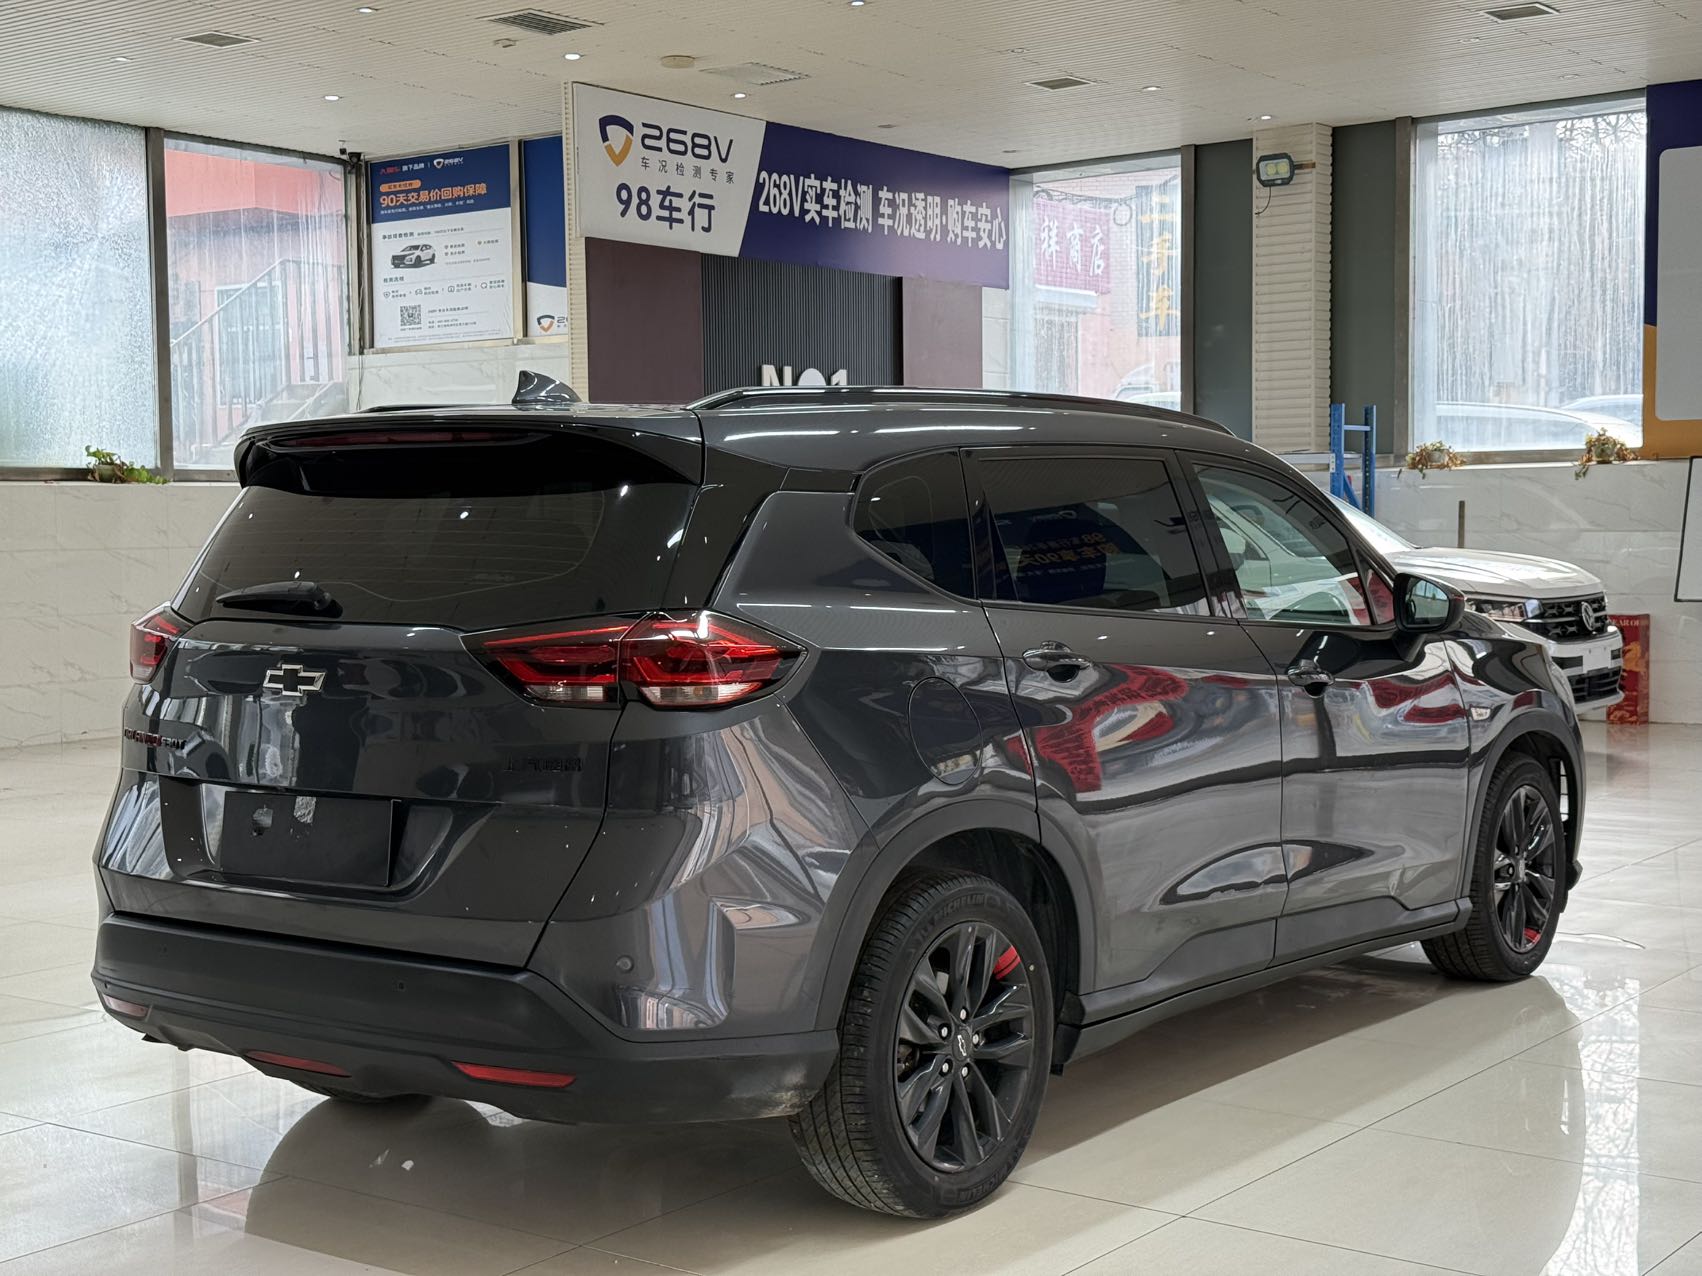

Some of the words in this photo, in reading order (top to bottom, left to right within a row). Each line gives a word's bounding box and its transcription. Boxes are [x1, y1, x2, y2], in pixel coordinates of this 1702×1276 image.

[640, 122, 734, 164] 268V
[640, 156, 735, 185] 车况检测专家
[380, 183, 487, 208] 90天交易价回购保障
[615, 182, 716, 233] 98车行
[758, 170, 873, 234] 268V实车检测
